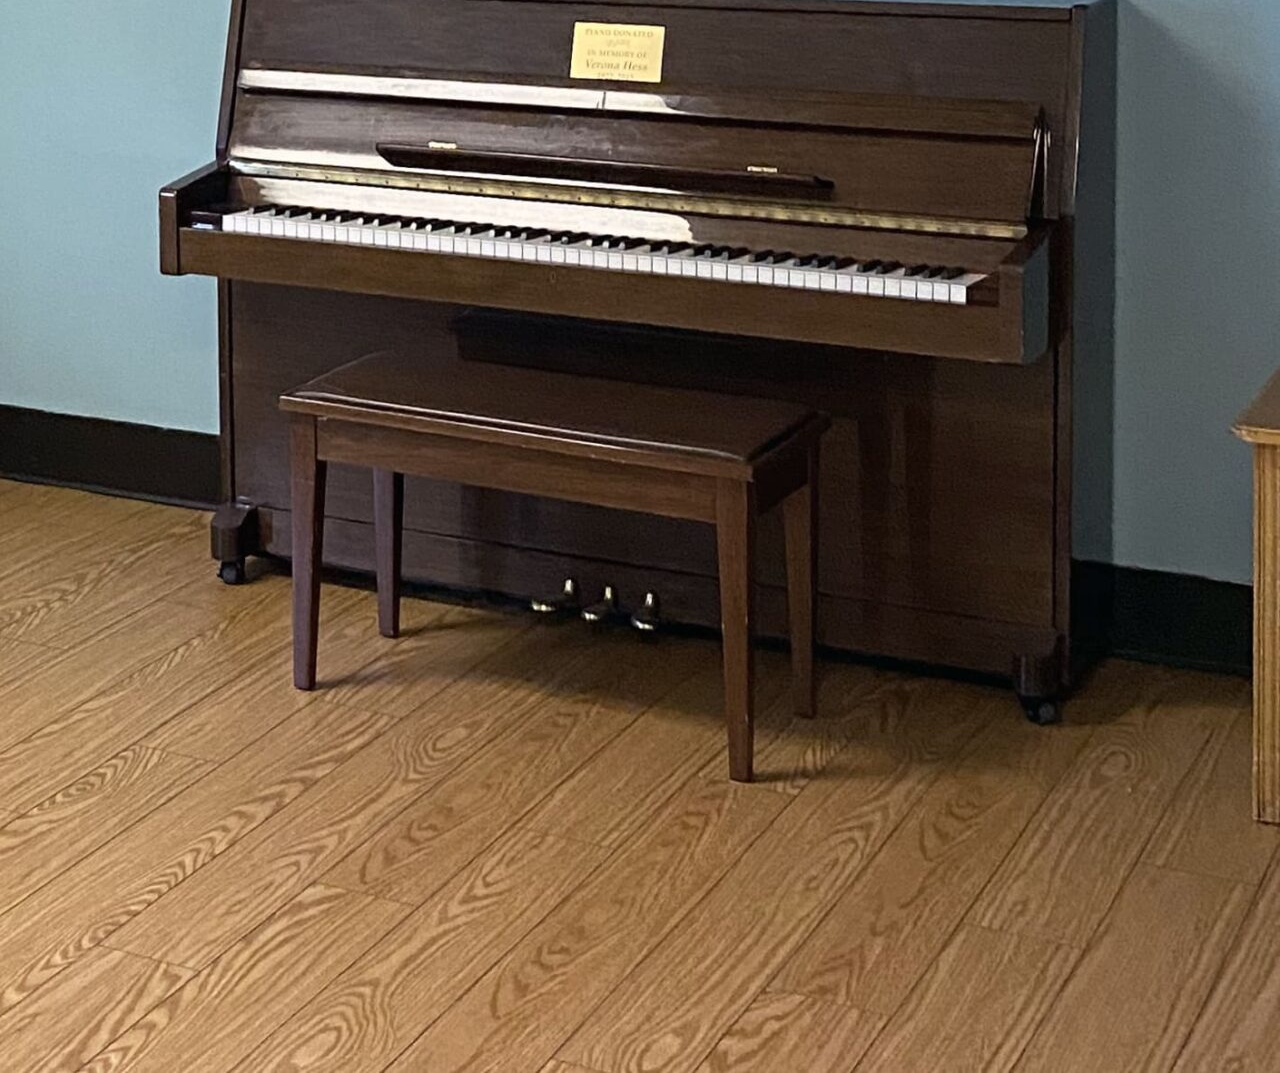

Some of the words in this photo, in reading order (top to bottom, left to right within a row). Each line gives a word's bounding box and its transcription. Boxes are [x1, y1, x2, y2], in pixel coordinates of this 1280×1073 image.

[585, 28, 611, 37] PIANO
[613, 29, 654, 39] DONATED
[599, 49, 634, 59] MEMORY
[586, 58, 620, 70] Verona
[623, 61, 648, 71] Hess
